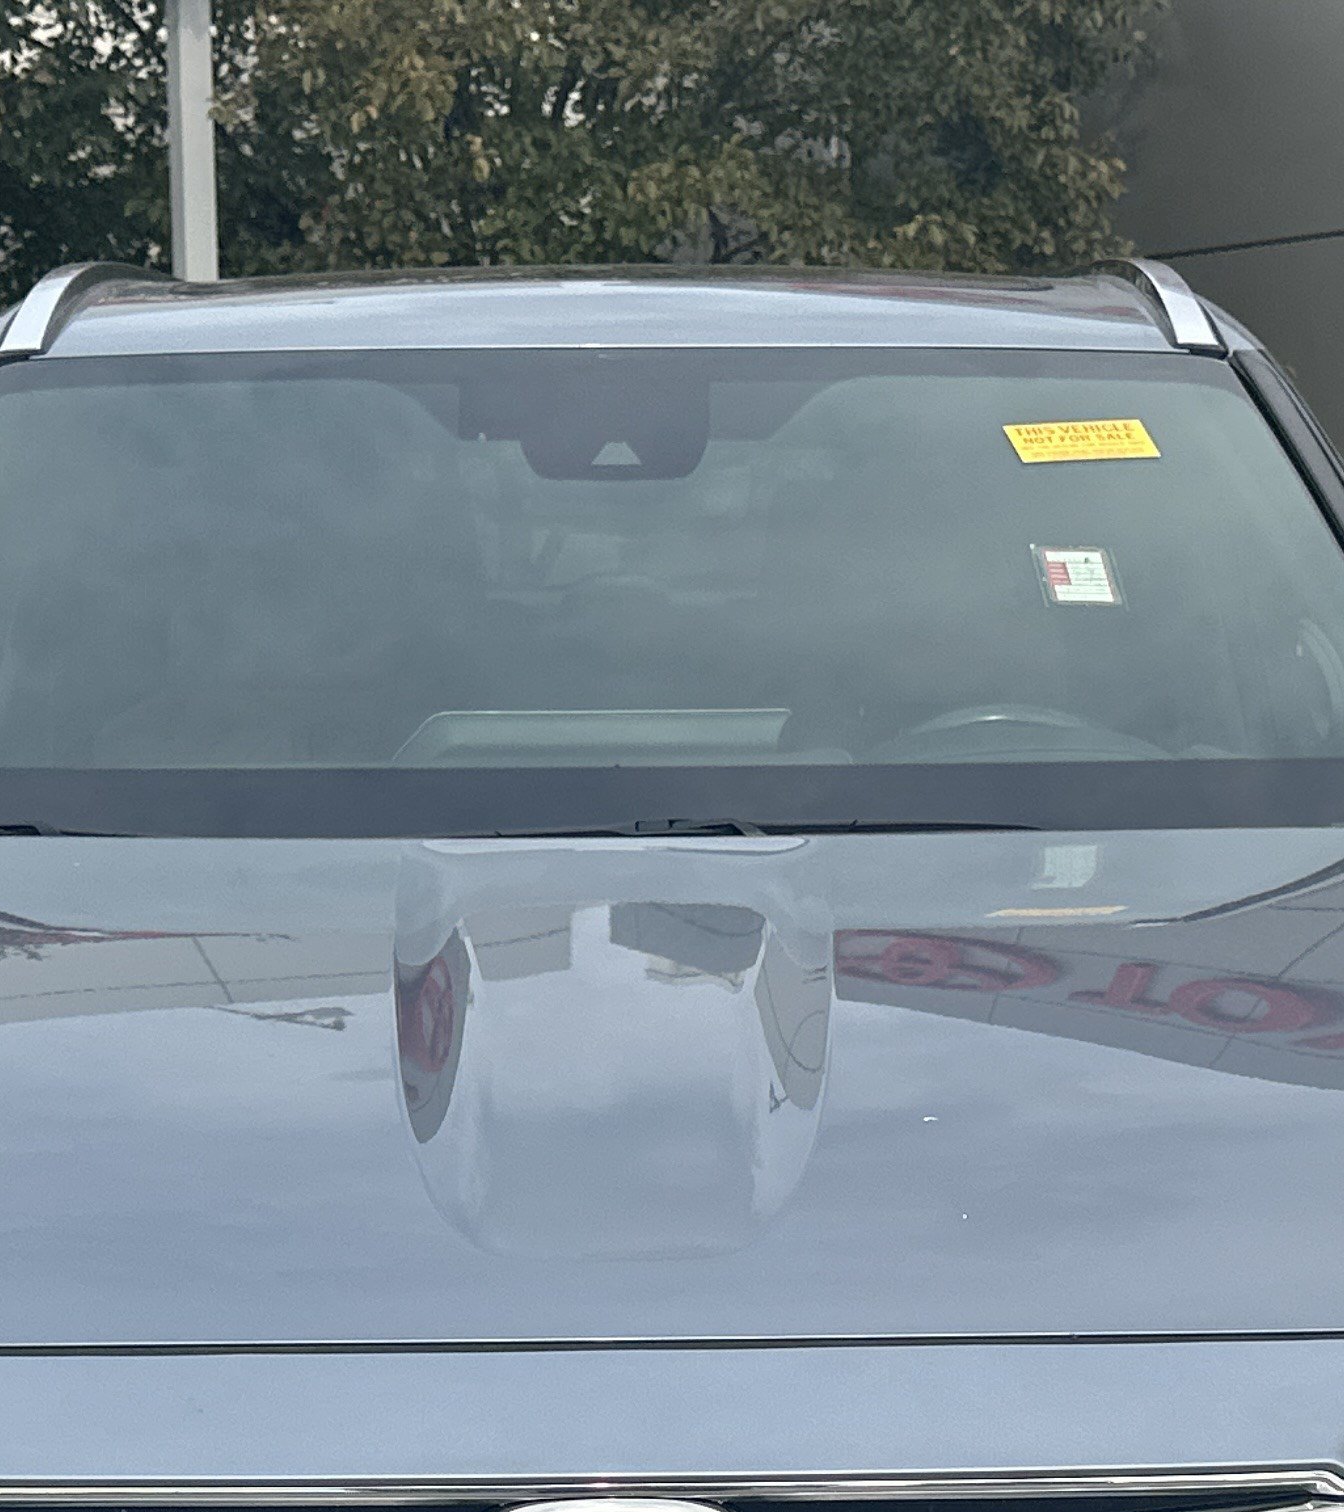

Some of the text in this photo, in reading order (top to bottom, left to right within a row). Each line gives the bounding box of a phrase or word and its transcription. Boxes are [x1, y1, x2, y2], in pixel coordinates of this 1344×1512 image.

[1014, 422, 1136, 437] THIS VEHICLE
[1022, 432, 1136, 444] NOT FOR SALE
